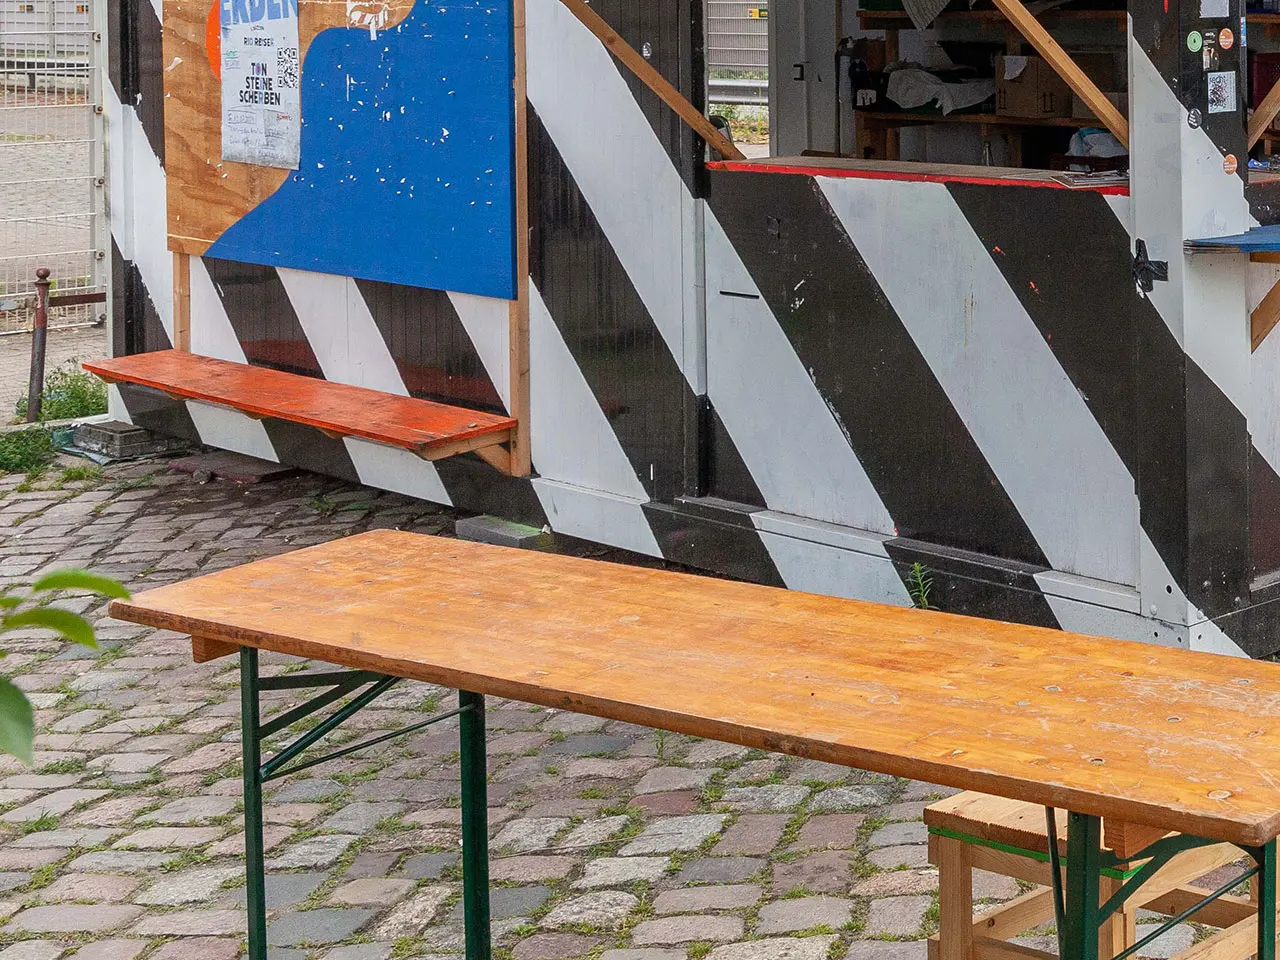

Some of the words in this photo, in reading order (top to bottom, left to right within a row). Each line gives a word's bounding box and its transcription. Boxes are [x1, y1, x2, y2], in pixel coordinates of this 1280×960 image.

[250, 62, 267, 76] TON
[245, 76, 273, 91] STEINE
[239, 90, 281, 106] SCHERBEN
